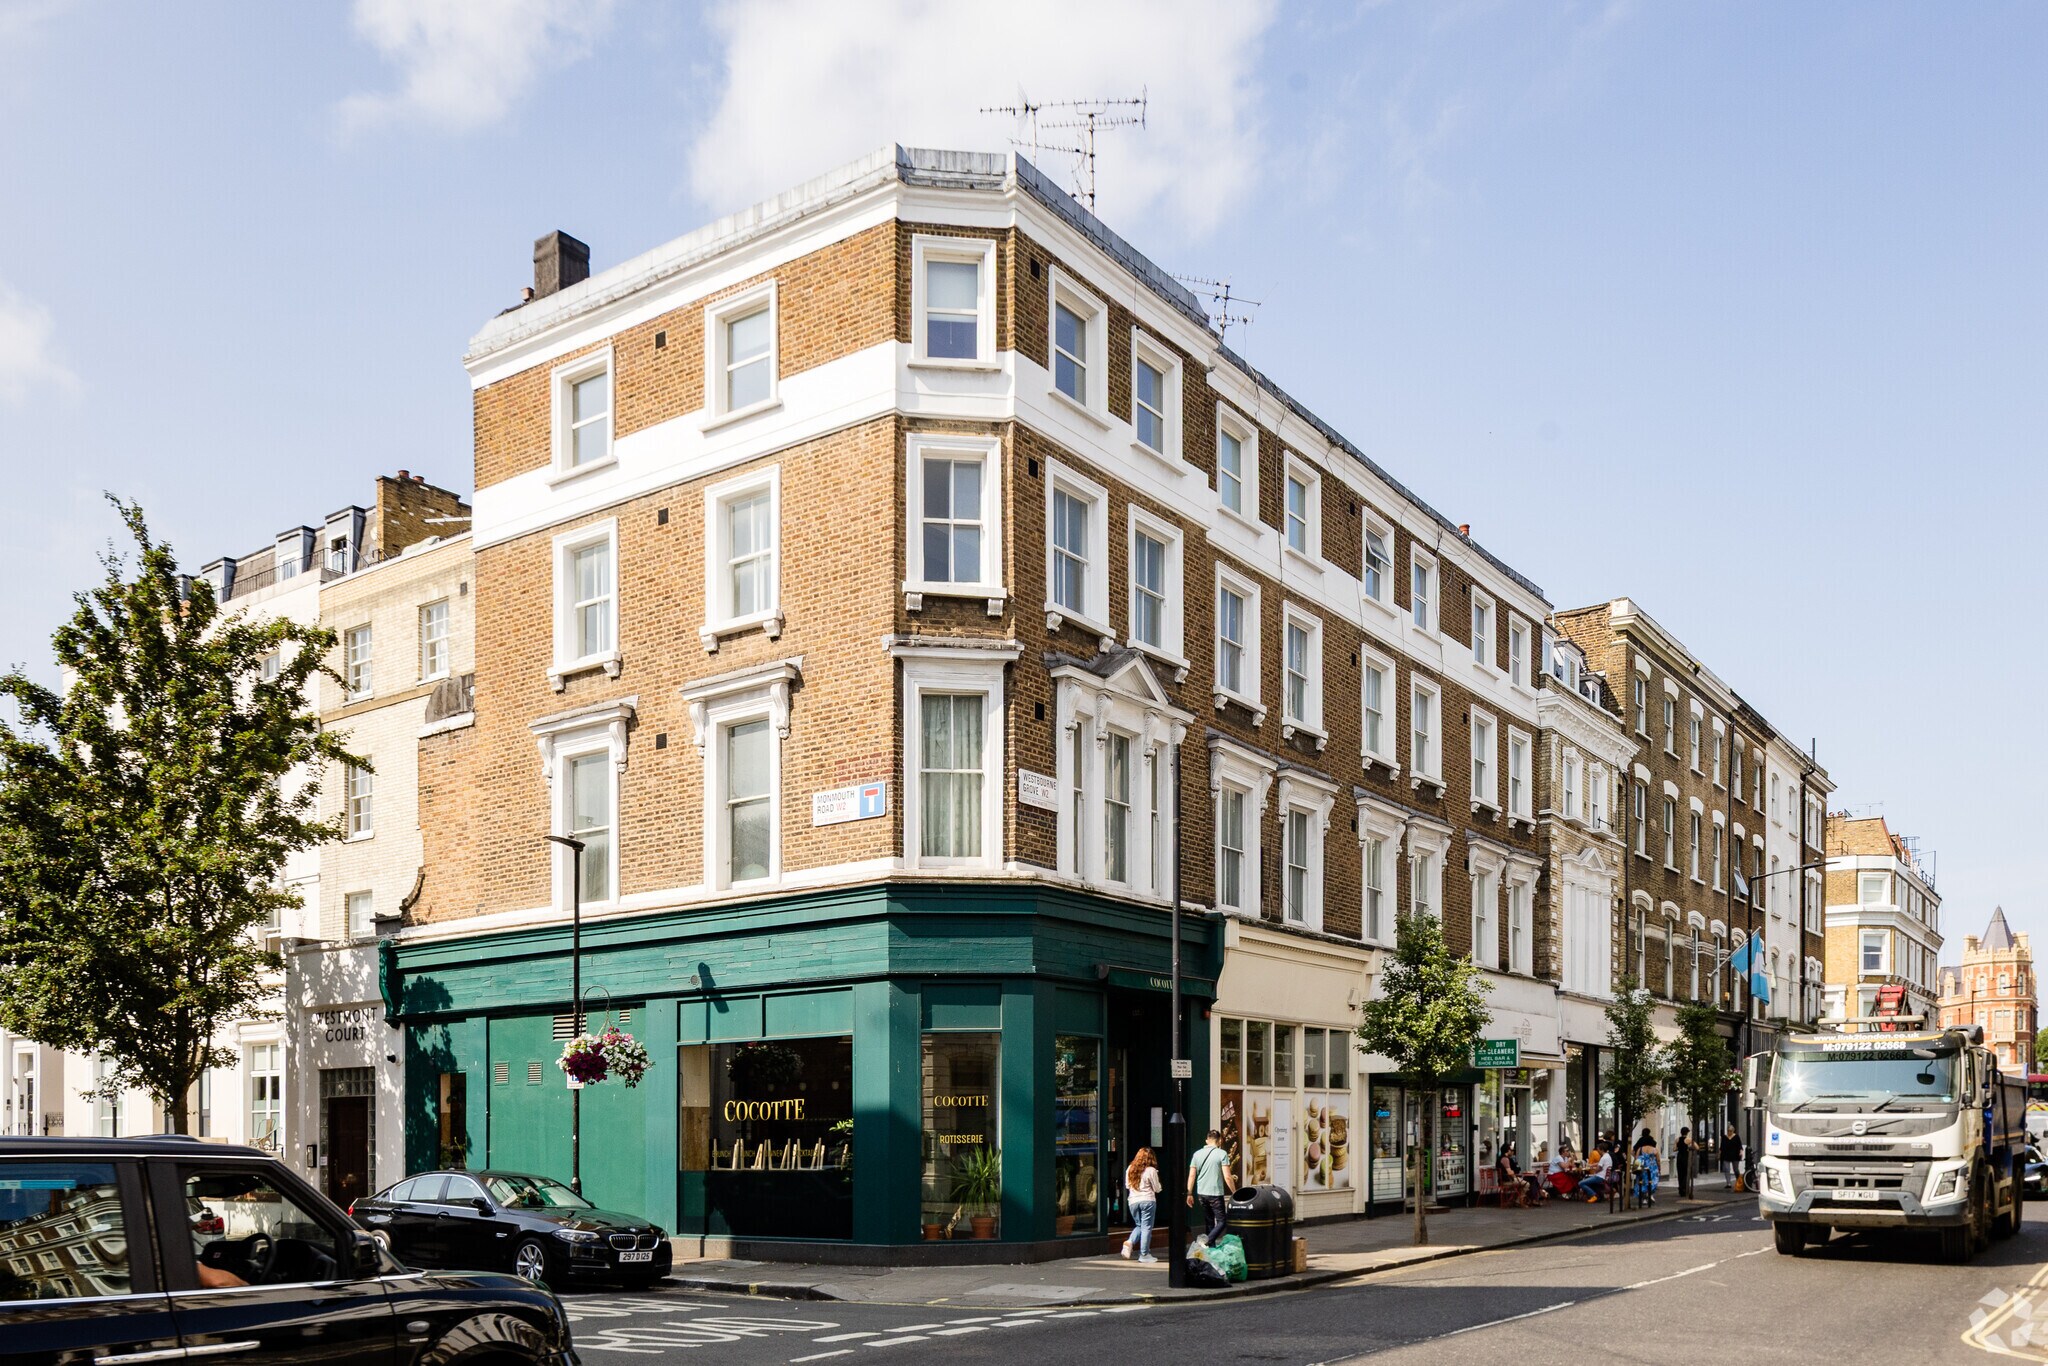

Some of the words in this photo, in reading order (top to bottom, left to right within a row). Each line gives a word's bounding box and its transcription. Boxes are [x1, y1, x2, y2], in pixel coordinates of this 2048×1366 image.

[816, 790, 855, 804] MONMOUTH
[816, 803, 835, 814] ROAD
[836, 802, 847, 811] W2
[315, 1007, 378, 1025] WESTMONT
[325, 1026, 366, 1043] COURT
[1813, 1032, 1920, 1042] www.link2london.co.uk
[1822, 1042, 1872, 1052] M:079122
[1873, 1041, 1907, 1050] 02668
[934, 1095, 989, 1107] COCOTTE
[724, 1098, 805, 1122] COCOTTE
[939, 1134, 984, 1144] ROTISSERIE
[1837, 1191, 1856, 1199] SF17
[622, 1252, 636, 1261] 297
[572, 1316, 841, 1354] ROAD
